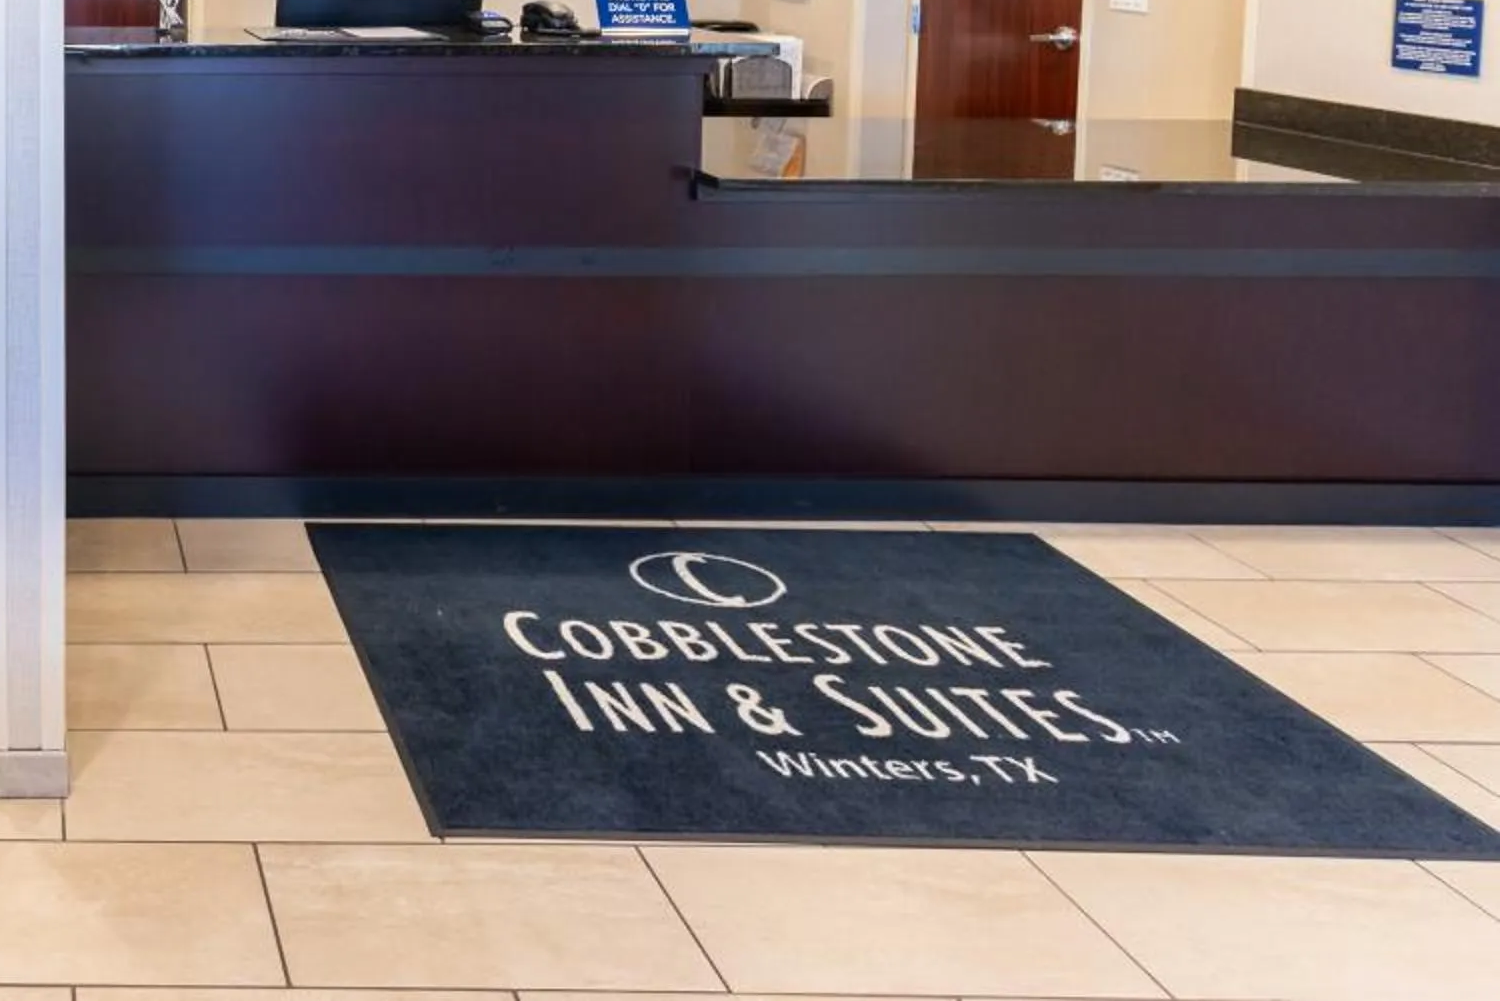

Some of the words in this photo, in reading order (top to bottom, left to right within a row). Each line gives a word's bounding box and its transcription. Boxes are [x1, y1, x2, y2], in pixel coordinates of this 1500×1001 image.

[608, 3, 633, 12] DIAL
[653, 3, 676, 12] FOR
[611, 14, 676, 24] ASSISTANCE.
[503, 611, 1052, 669] COBBLESTONE
[543, 670, 715, 735] INN
[726, 683, 803, 736] &
[813, 673, 1131, 744] SUITES
